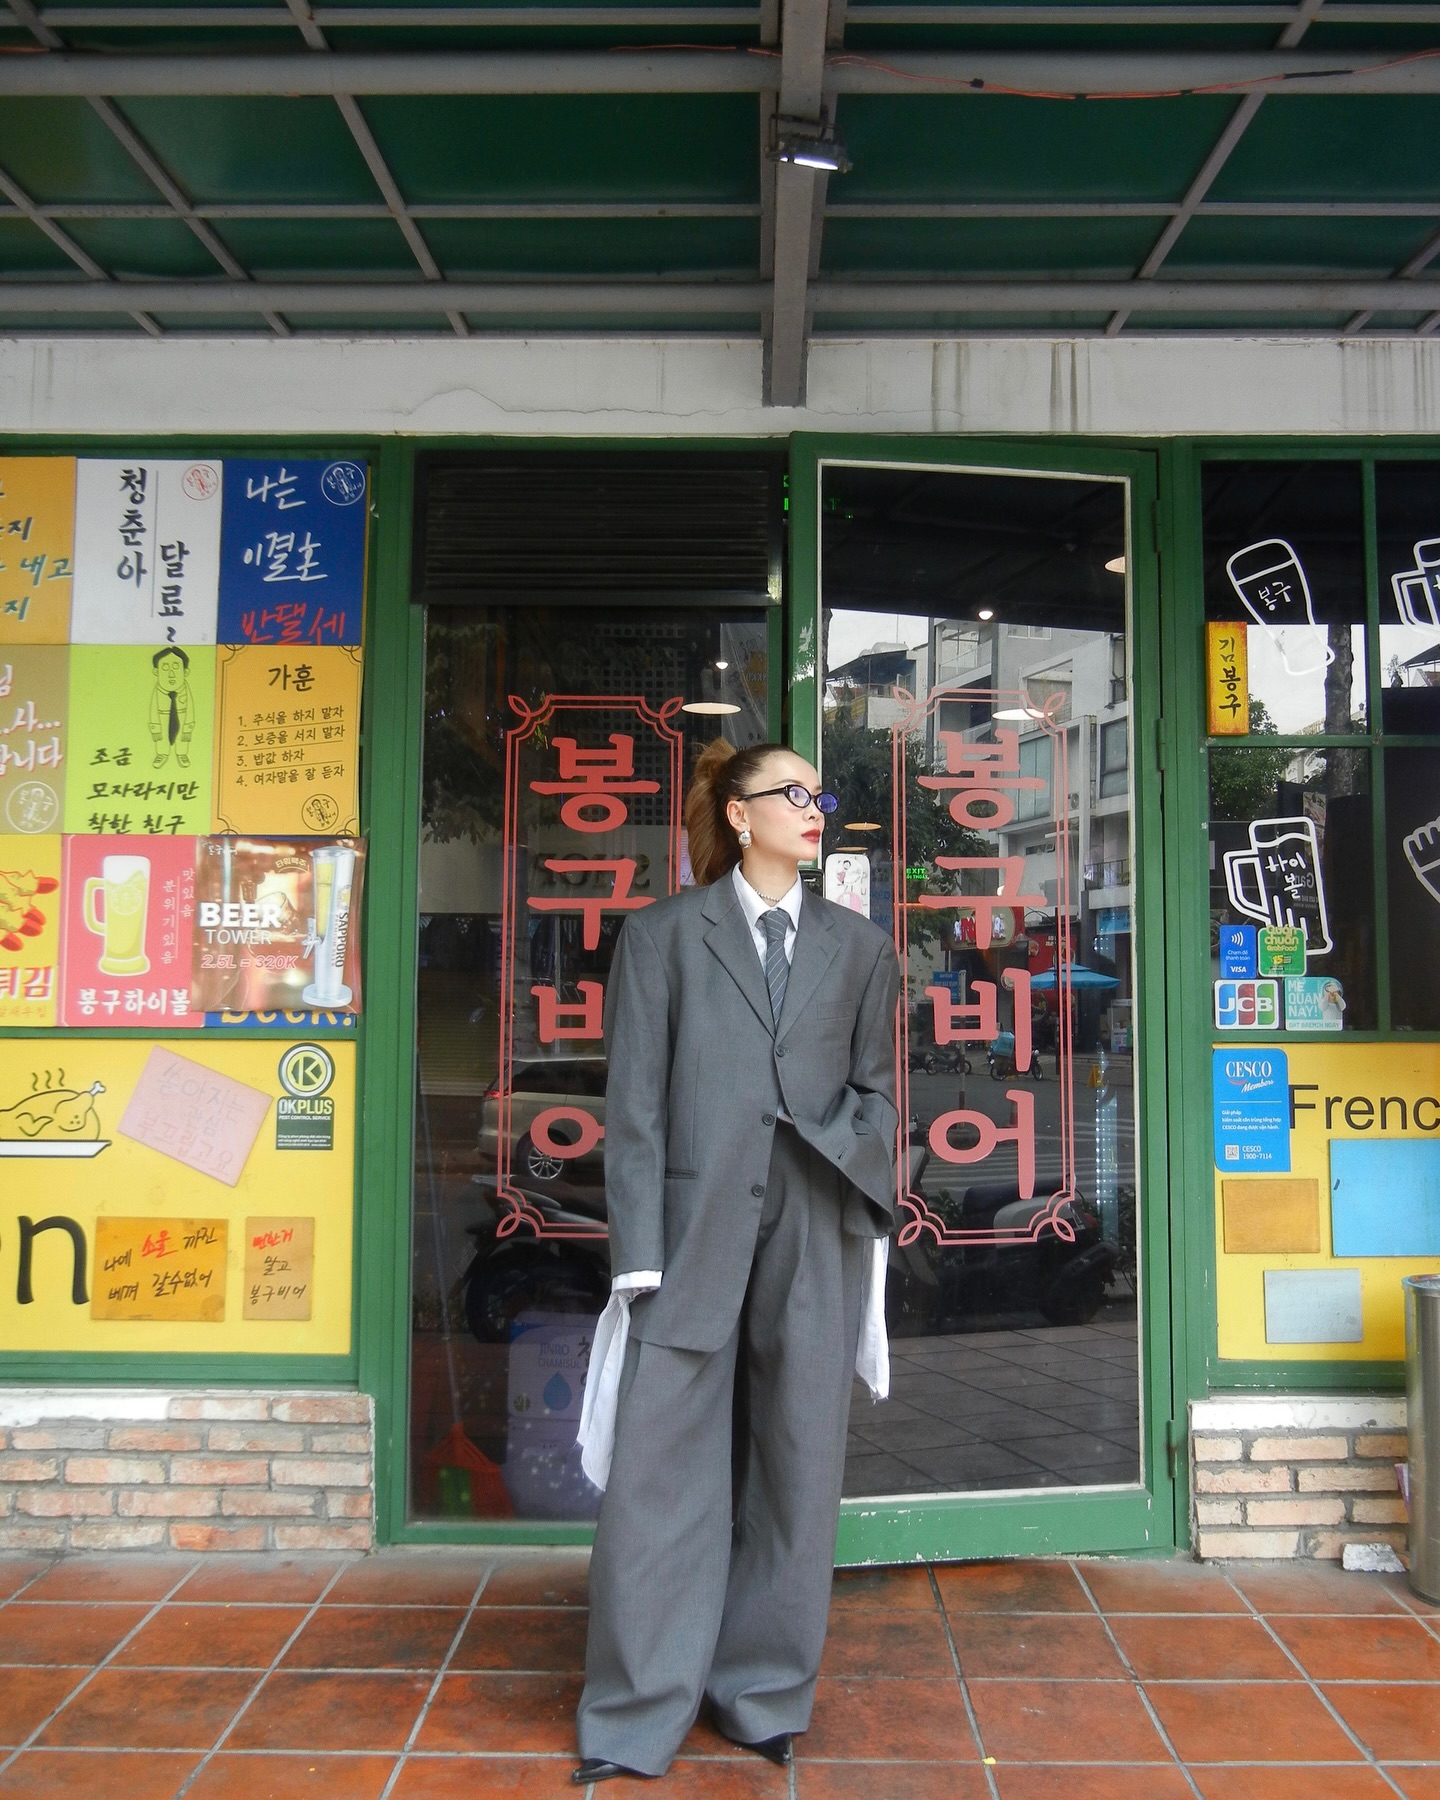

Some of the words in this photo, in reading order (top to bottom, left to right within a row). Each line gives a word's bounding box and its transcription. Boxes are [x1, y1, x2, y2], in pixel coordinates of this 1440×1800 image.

[247, 467, 307, 510] 나는
[116, 467, 148, 588] 청춘아
[268, 664, 316, 692] 가훈
[238, 715, 247, 728] 1.
[252, 711, 287, 726] 주식을
[292, 708, 316, 722] 하지
[321, 705, 344, 719] 말자
[237, 735, 248, 748] 2.
[253, 730, 288, 745] 보증을
[294, 727, 316, 742] 서지
[322, 725, 345, 739] 말자
[89, 748, 133, 767] 조금
[236, 755, 247, 767] 3.
[253, 752, 276, 766] 밥값
[282, 749, 304, 762] 하자
[236, 775, 248, 787] 4.
[253, 769, 299, 785] 여자말을
[304, 767, 316, 780] 잘
[321, 764, 345, 779] 듣자
[86, 781, 199, 801] 모자라지만
[88, 813, 132, 834] 착한
[143, 814, 186, 834] 친구
[1265, 852, 1306, 873] 하이
[199, 902, 283, 928] BEER
[205, 929, 272, 945] TOWER
[201, 955, 237, 969] 2.5L
[255, 955, 299, 969] 320K
[916, 729, 1047, 1200] 봉구비어
[78, 988, 191, 1016] 봉구하이볼
[1219, 997, 1273, 1012] JCB
[1225, 1061, 1272, 1077] CESCO
[1241, 1078, 1274, 1093] Members
[279, 1099, 333, 1114] OKPLUS
